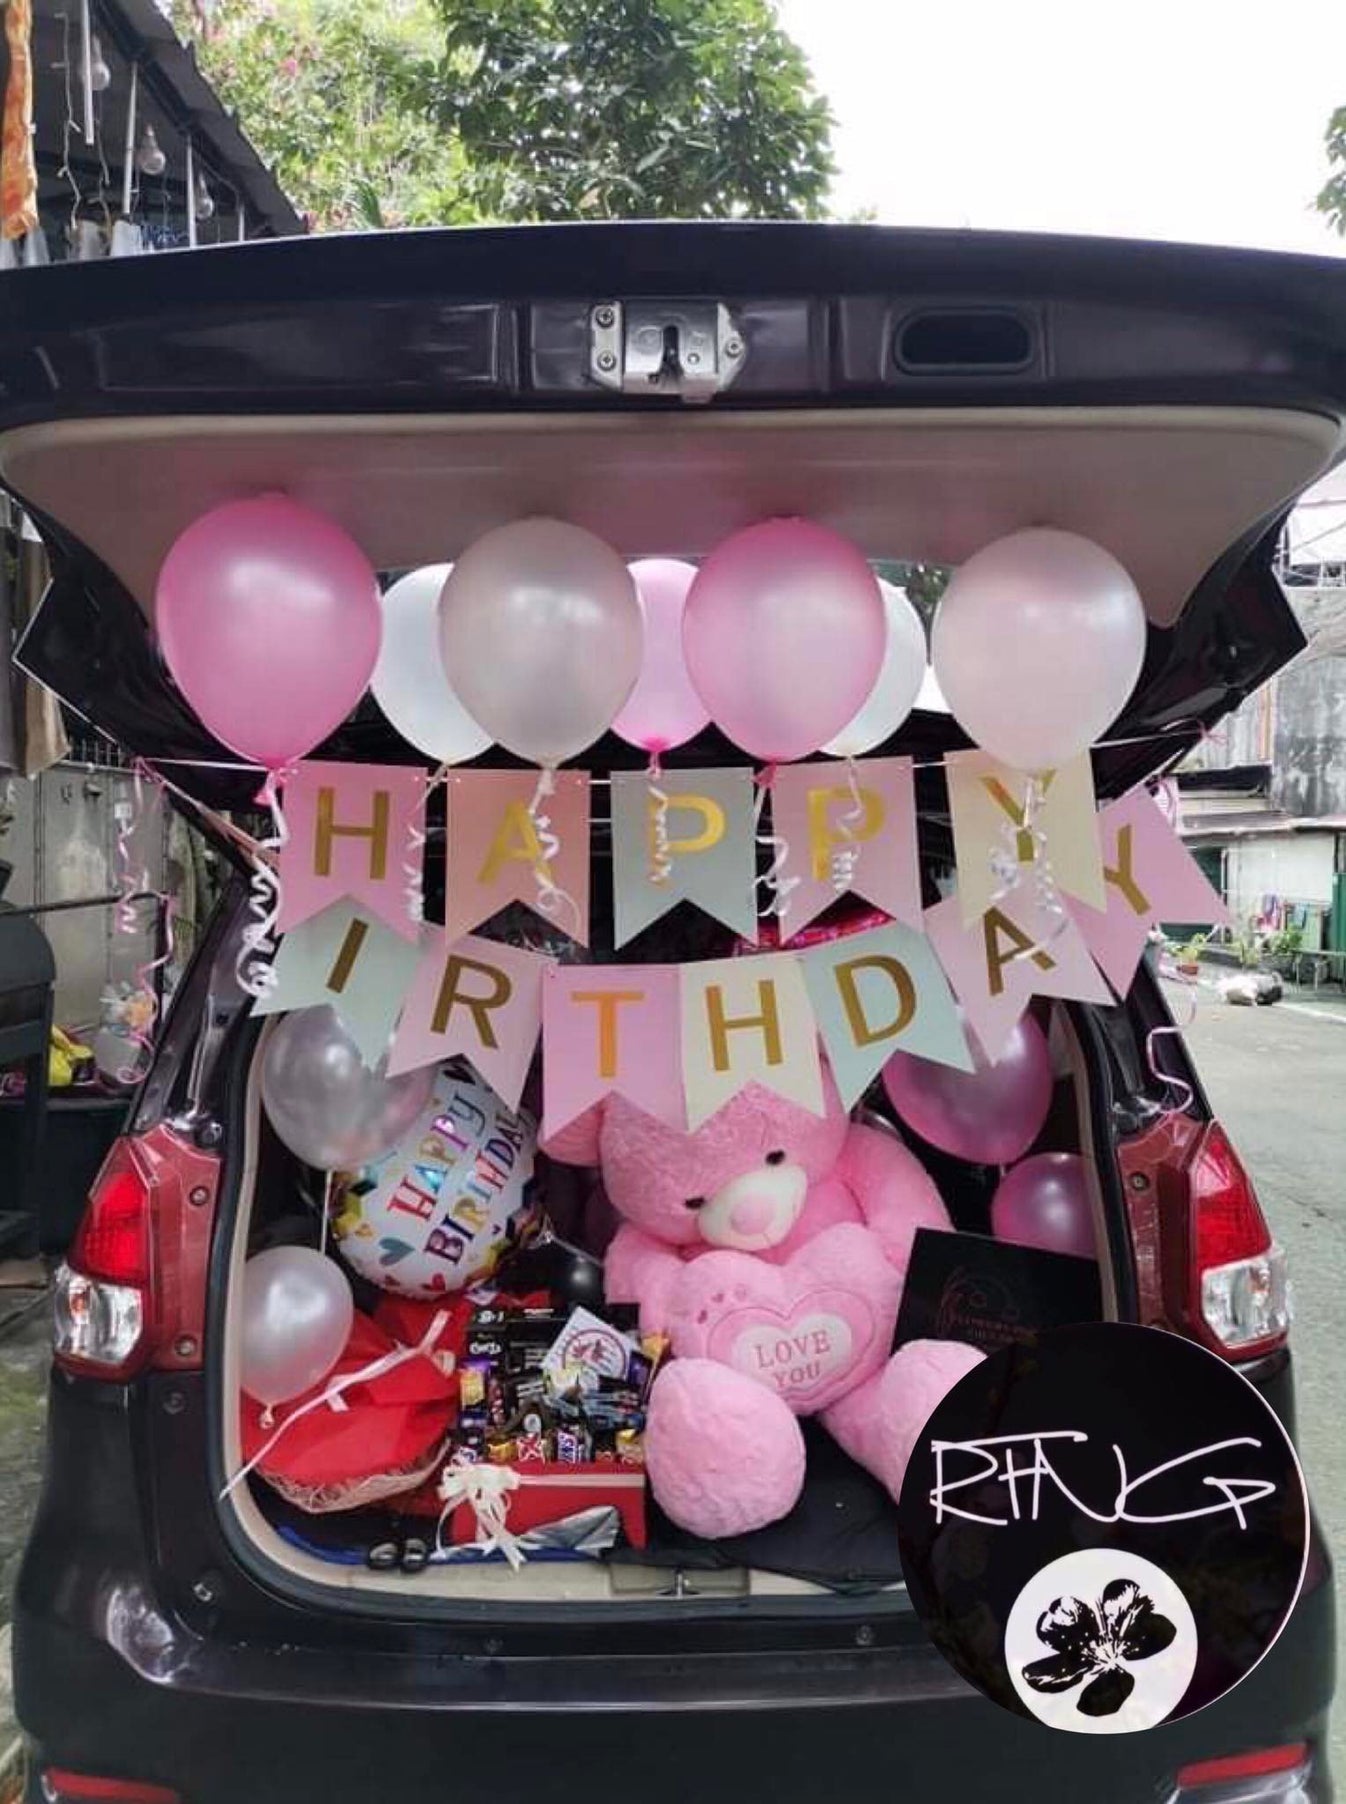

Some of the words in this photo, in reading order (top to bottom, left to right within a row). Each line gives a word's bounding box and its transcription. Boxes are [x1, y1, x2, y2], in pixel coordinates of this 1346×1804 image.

[315, 769, 1056, 887] HAPPY
[326, 823, 1152, 1079] IRTHDAY
[387, 1093, 486, 1222] HAPPY
[754, 1328, 831, 1369] LOVE
[773, 1361, 821, 1390] YOU
